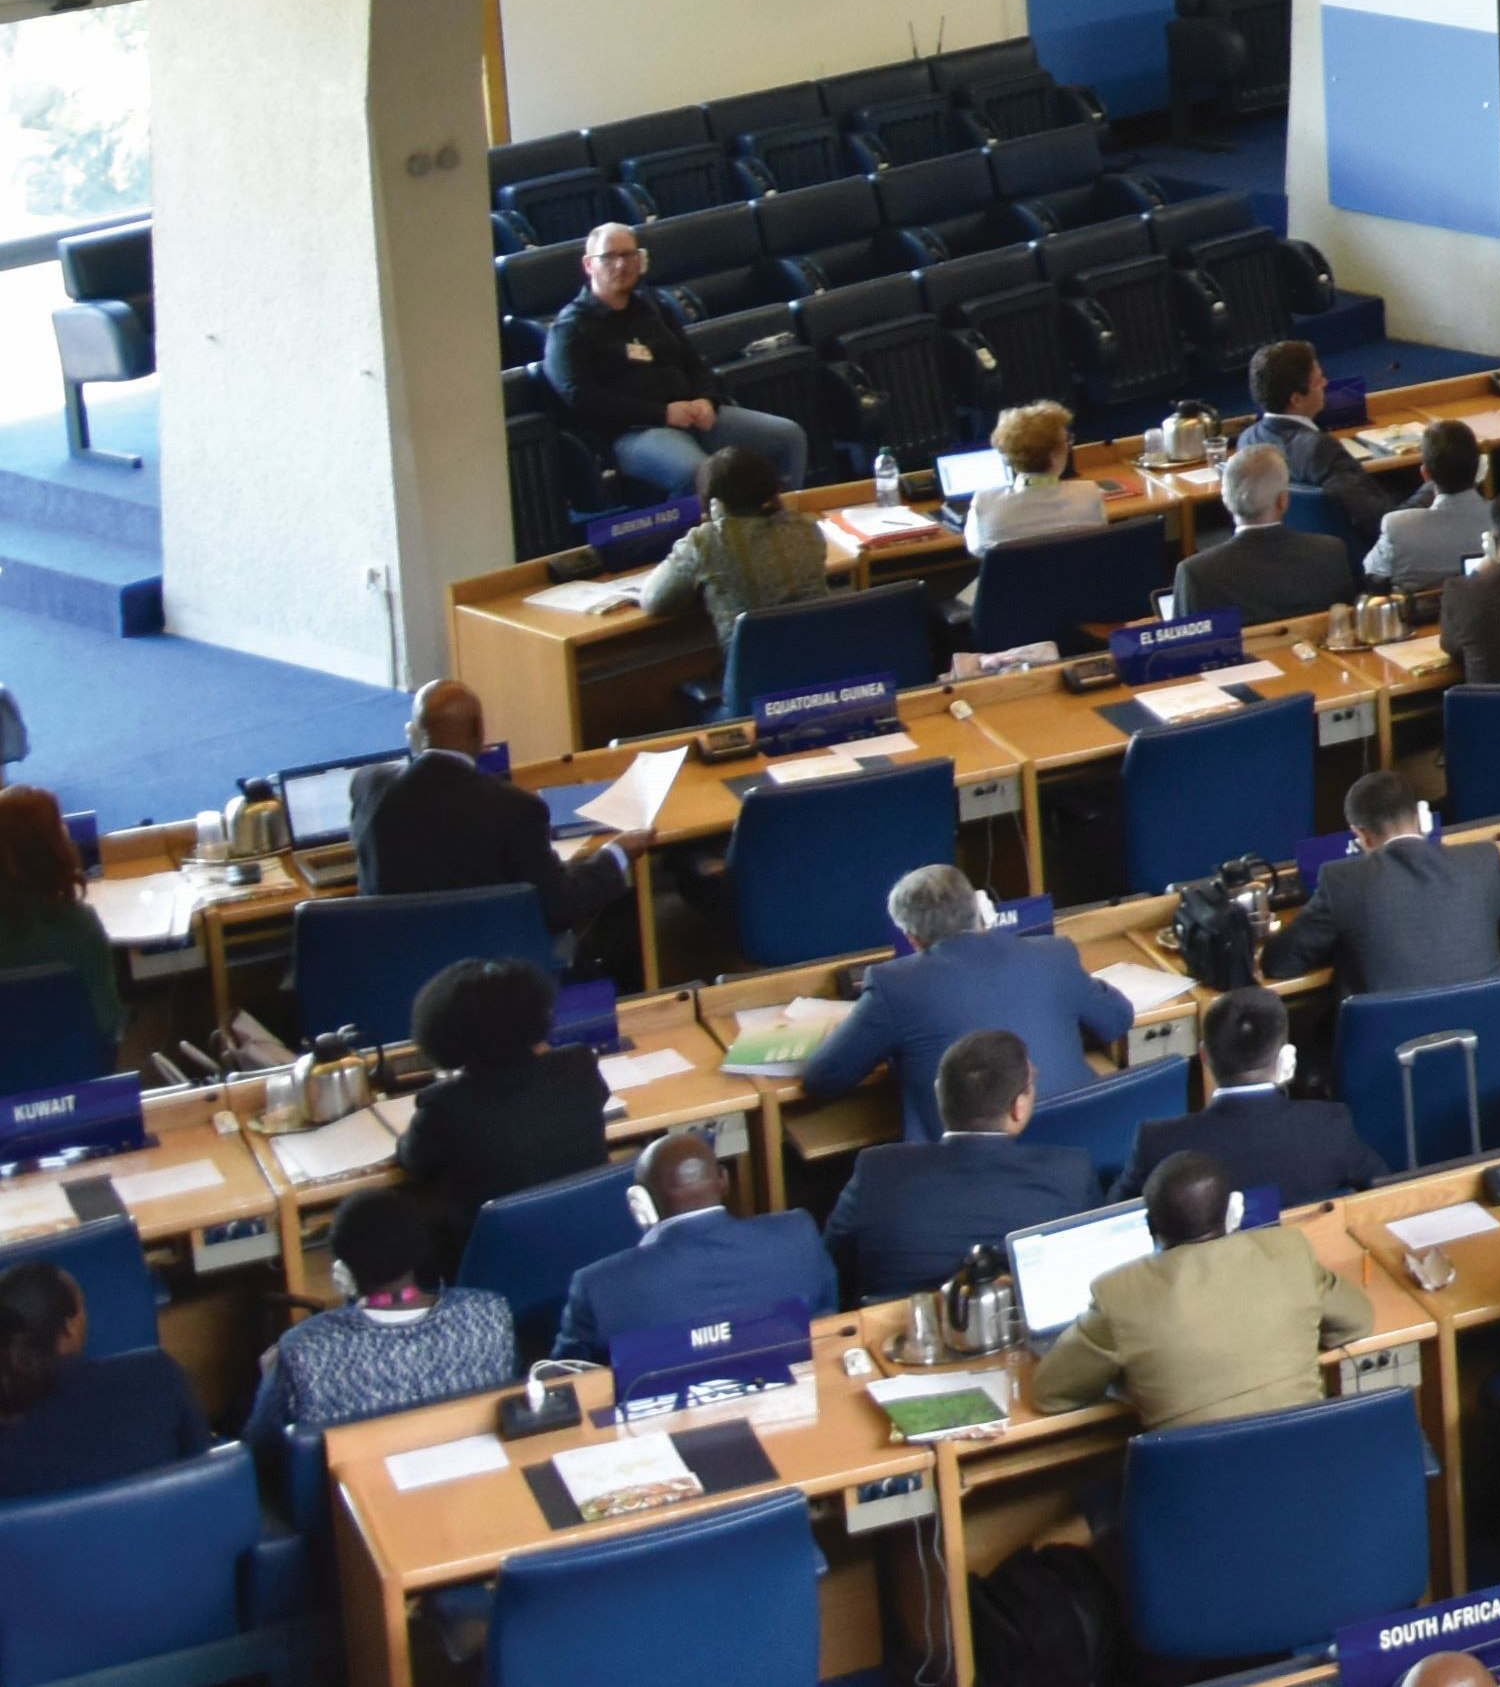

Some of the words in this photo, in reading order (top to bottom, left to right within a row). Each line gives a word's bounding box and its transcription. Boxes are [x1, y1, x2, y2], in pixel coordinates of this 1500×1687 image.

[612, 516, 653, 537] BURKINA
[655, 508, 680, 525] FASO
[1140, 632, 1155, 646] EL
[1156, 619, 1213, 642] SALVADOR
[765, 691, 837, 716] EQUATORIAL
[840, 681, 885, 703] GUINEA
[14, 1095, 76, 1123] KUWAIT
[691, 1321, 732, 1348] NIUE
[1379, 1615, 1438, 1650] SOUTH
